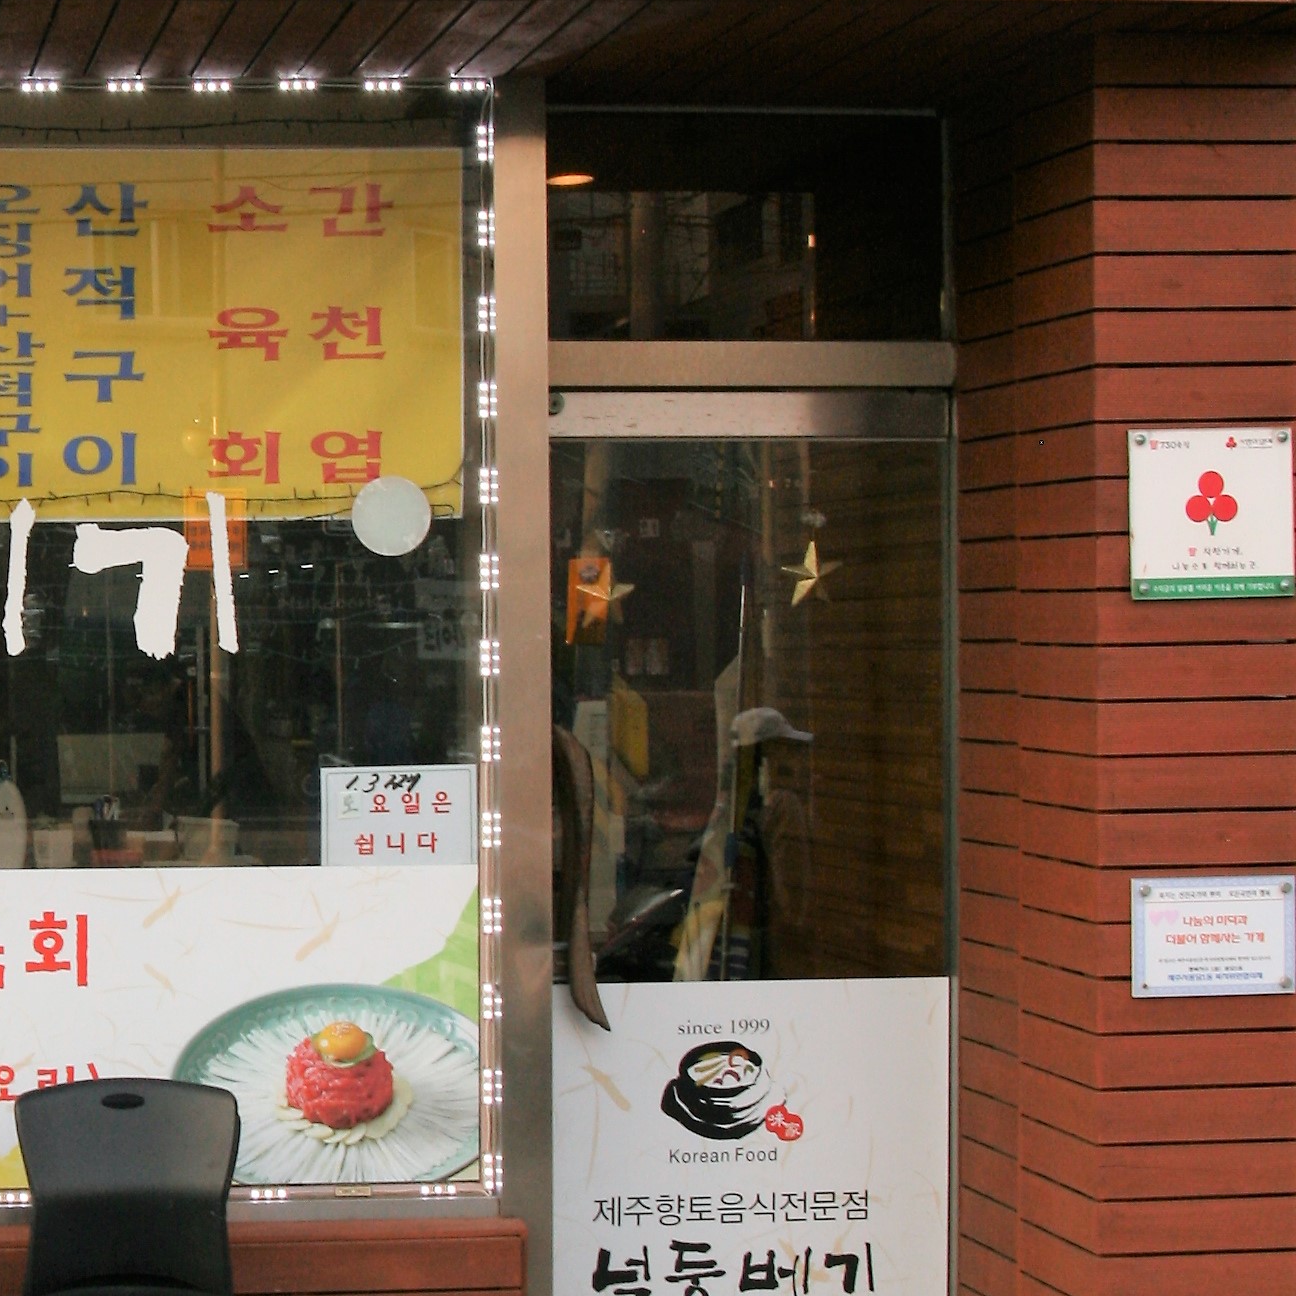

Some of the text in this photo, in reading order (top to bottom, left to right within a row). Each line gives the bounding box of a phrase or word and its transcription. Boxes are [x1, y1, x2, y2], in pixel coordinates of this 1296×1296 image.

[62, 182, 148, 485] 산적구이
[206, 186, 290, 486] 소육회
[308, 183, 394, 487] 간천엽
[355, 831, 438, 856] 쉽니다
[677, 1018, 771, 1035] since 1999
[668, 1147, 779, 1165] Korean Food
[592, 1189, 871, 1227] 제주향토음식전문점
